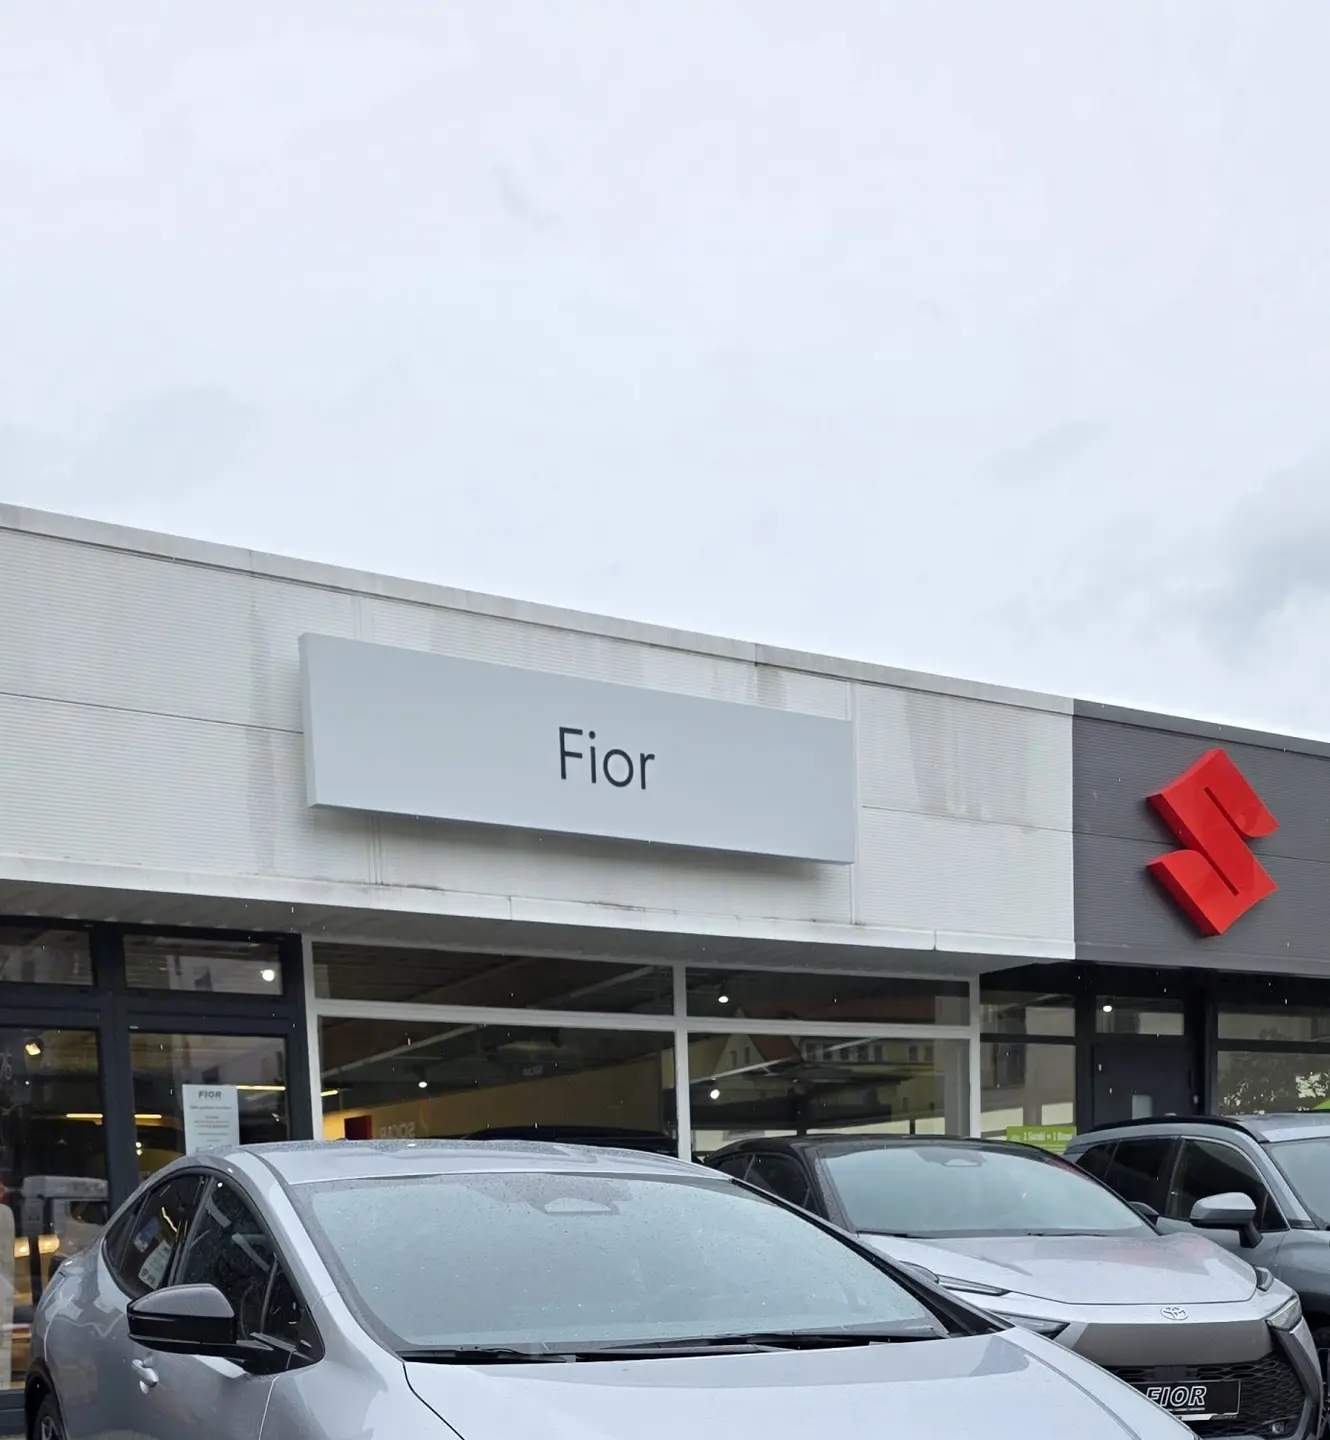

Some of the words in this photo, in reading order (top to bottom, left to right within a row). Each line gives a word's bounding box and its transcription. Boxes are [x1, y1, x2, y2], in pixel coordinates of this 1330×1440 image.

[559, 726, 655, 790] Fior
[198, 1090, 222, 1100] FIOR
[1146, 1386, 1207, 1407] FIOR
